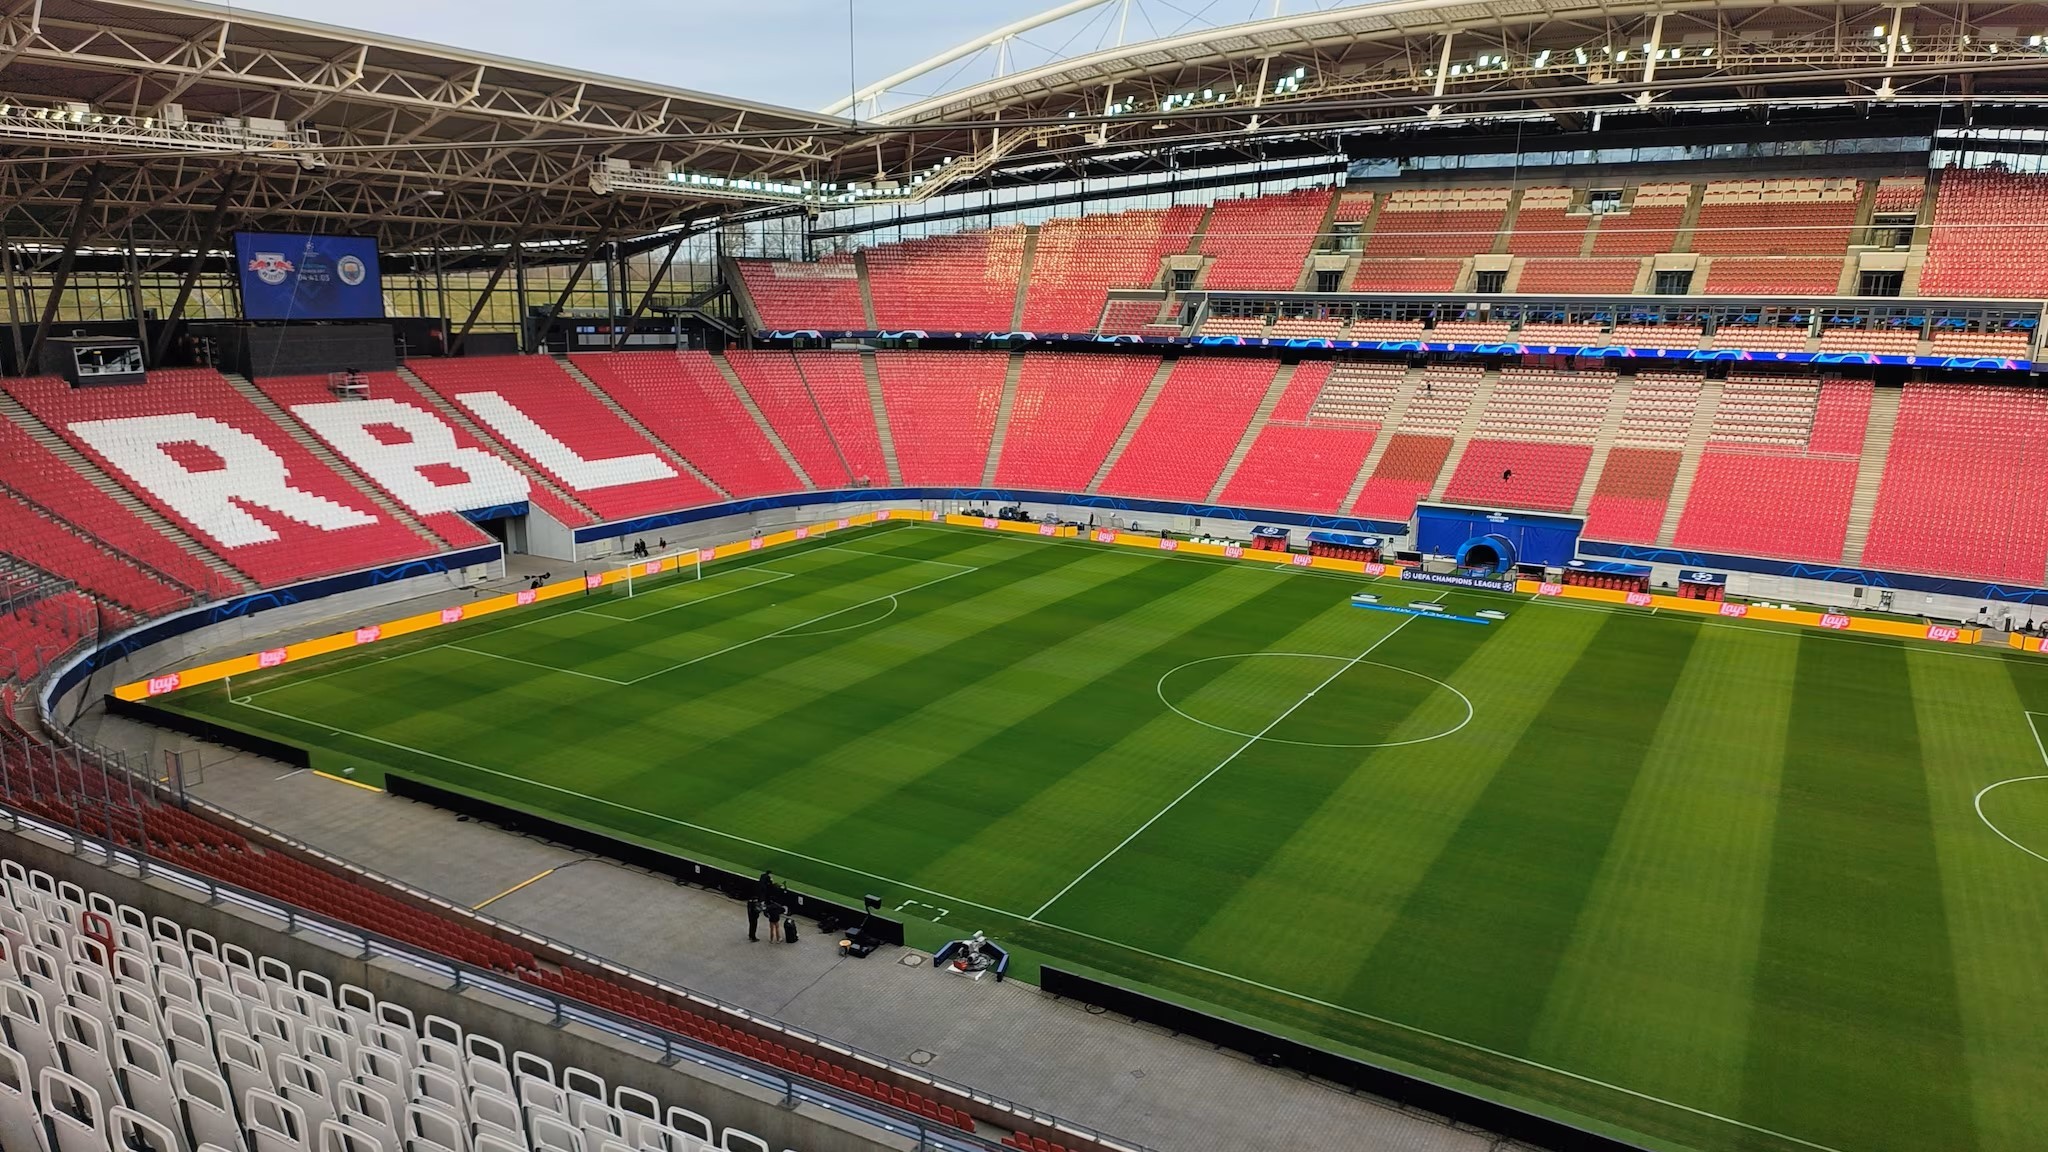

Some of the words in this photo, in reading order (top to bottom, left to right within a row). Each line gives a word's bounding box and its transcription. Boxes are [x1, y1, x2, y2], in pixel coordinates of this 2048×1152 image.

[68, 391, 678, 548] RBL
[1099, 532, 1115, 543] Lay's
[1161, 539, 1177, 550] Lay's
[1226, 546, 1243, 558] Lay's
[1294, 554, 1312, 566] Lay's
[1365, 563, 1385, 575] Lay's
[1413, 572, 1431, 581] UEFA
[1432, 574, 1473, 586] CHAMPIONS
[1474, 579, 1502, 590] LEAGUE
[1540, 583, 1562, 595] Lay's
[1627, 592, 1651, 606] Lay's
[1721, 603, 1747, 617] Lay's
[1821, 614, 1849, 629] Lay's
[356, 626, 380, 643] Lay's
[1928, 626, 1957, 642] Lay's
[260, 648, 286, 667] Lay's
[150, 674, 178, 695] Lay's
